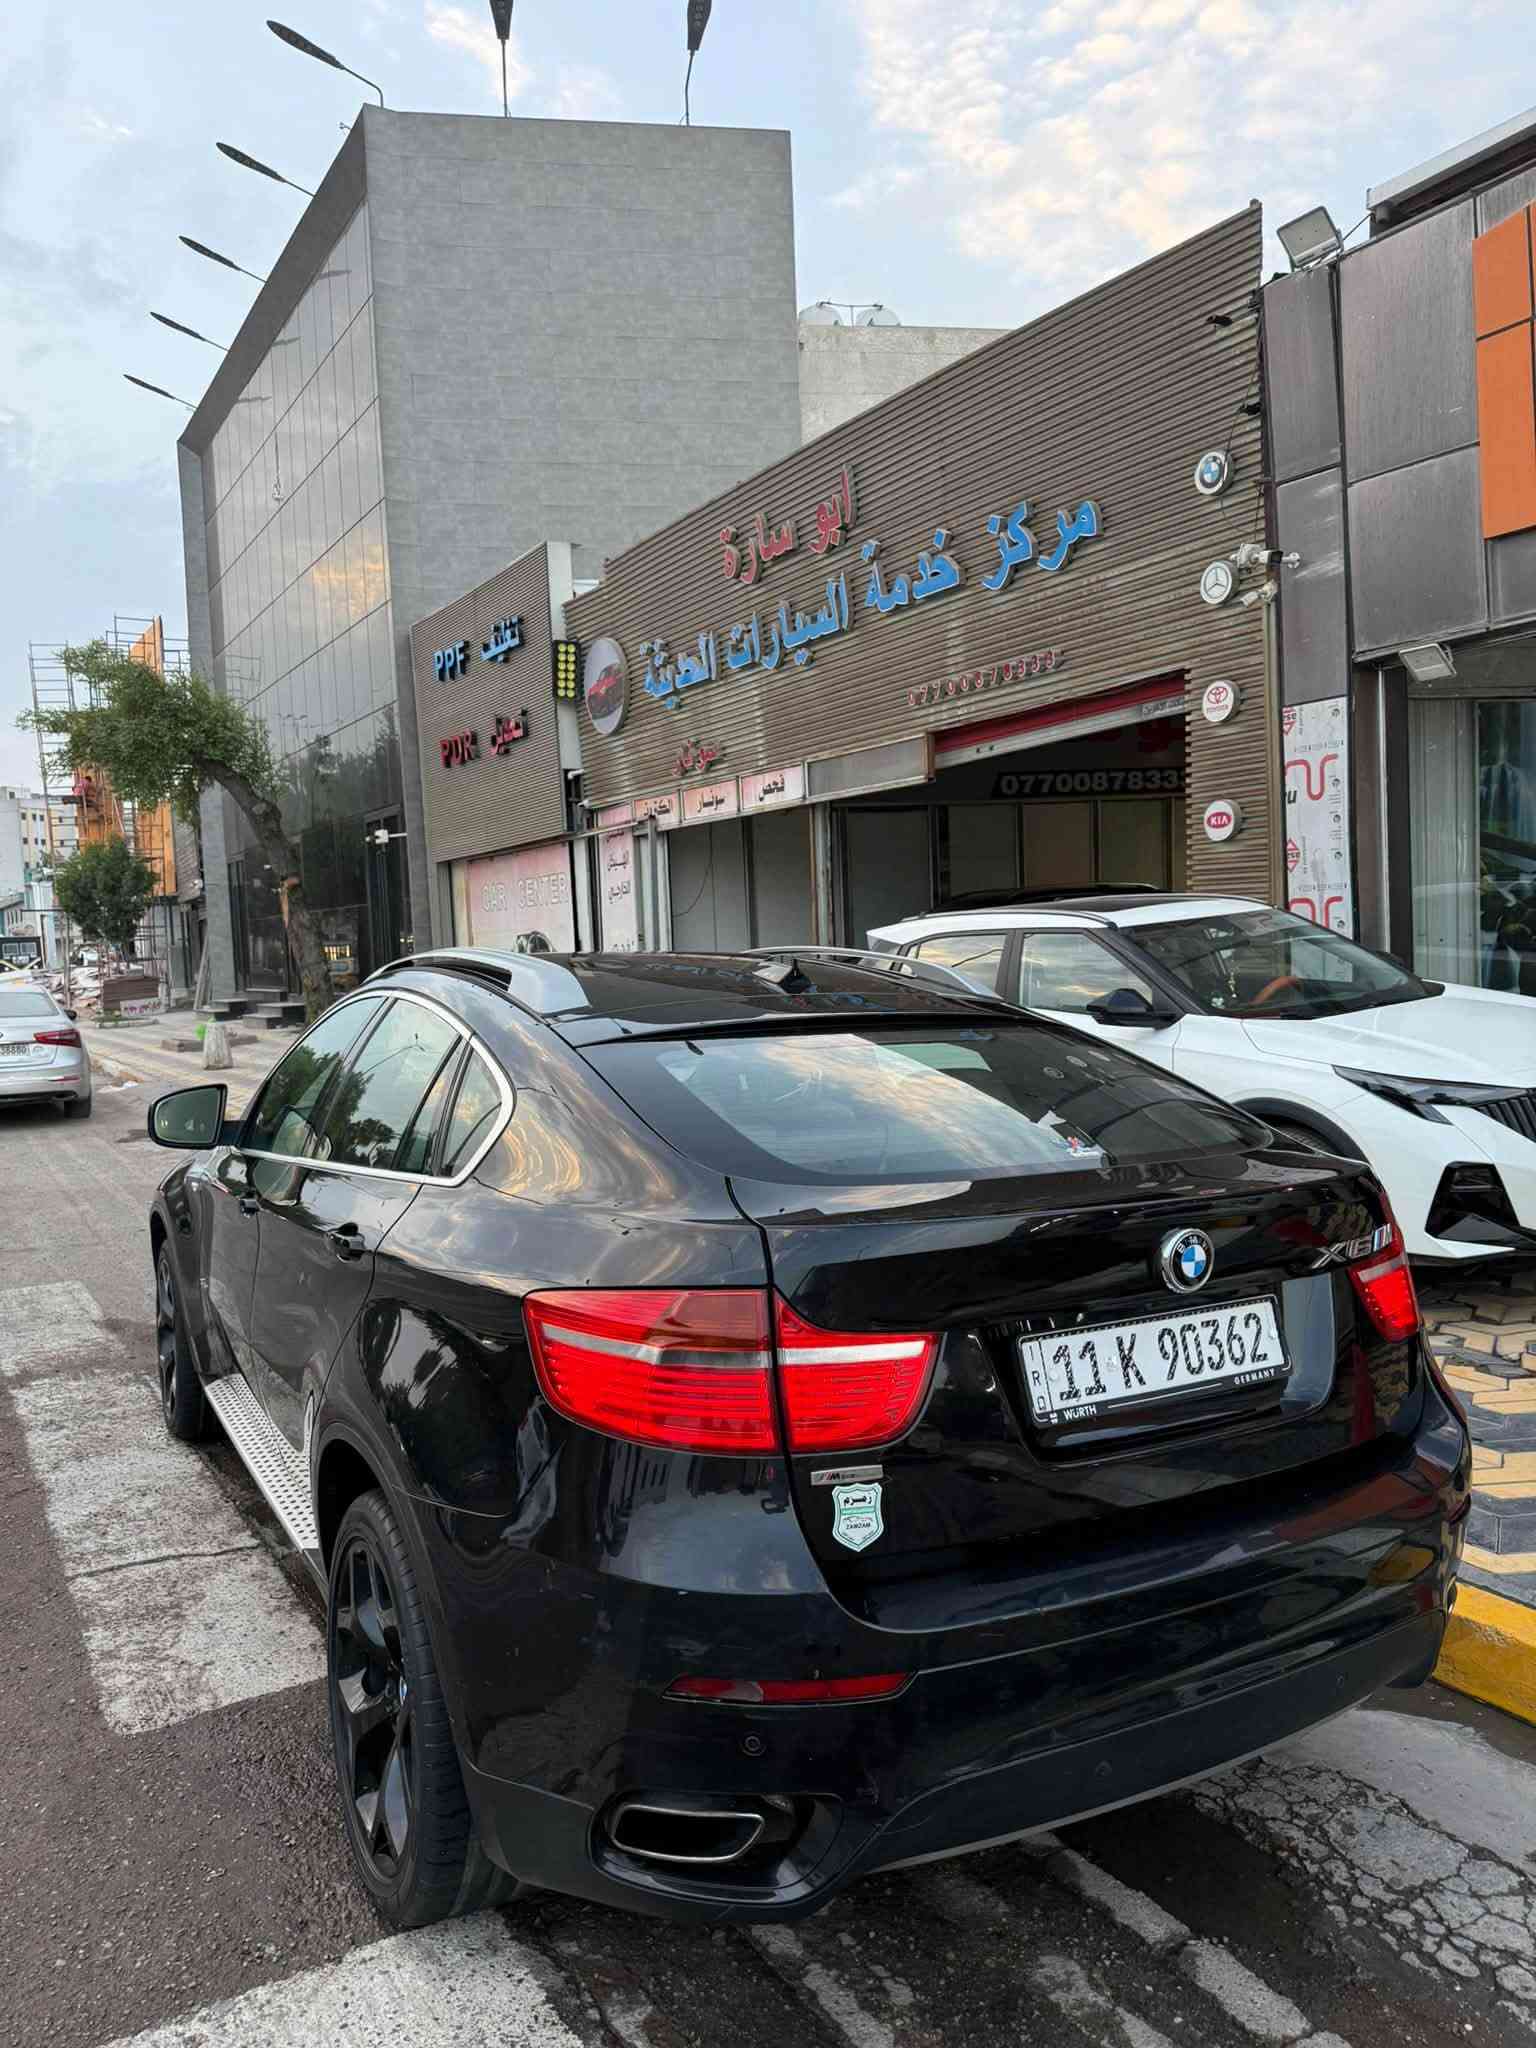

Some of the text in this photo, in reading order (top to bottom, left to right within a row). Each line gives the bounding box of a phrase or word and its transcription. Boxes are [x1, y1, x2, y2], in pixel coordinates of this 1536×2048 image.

[720, 464, 853, 584] ابو سارة
[640, 500, 1101, 710] مركز خدمة السيارات الحديثة
[432, 640, 467, 681] PPF
[439, 728, 475, 768] PDR
[1001, 769, 1186, 795] 0770087833
[1209, 815, 1229, 826] KIA
[1052, 1312, 1269, 1401] 11 K 90362
[1233, 1367, 1275, 1386] GERMANY
